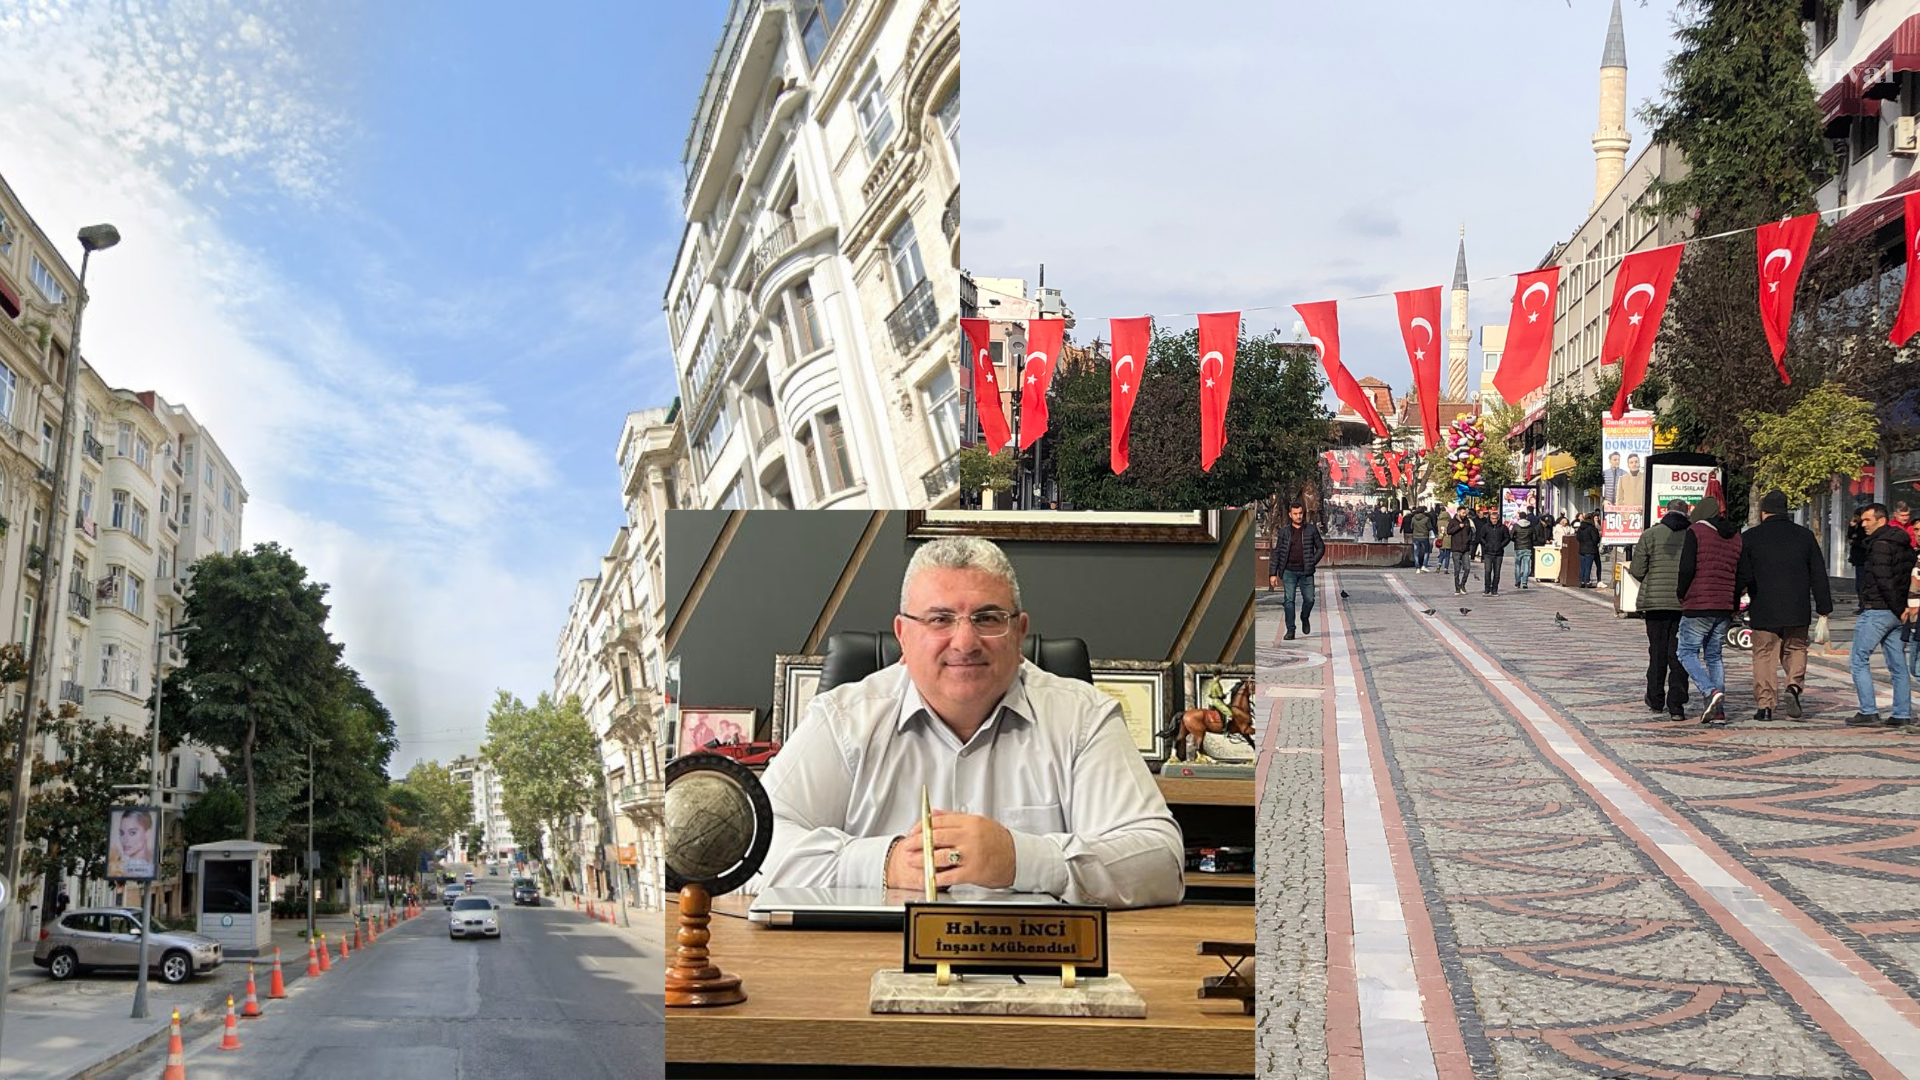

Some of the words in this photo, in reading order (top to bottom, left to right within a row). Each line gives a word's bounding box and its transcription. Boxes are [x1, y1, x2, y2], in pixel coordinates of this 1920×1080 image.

[1605, 440, 1651, 450] DONSUZ!
[946, 921, 1013, 934] Hakan
[1019, 920, 1066, 936] İNCİ
[936, 938, 985, 954] İnşaat
[991, 941, 1076, 954] Mühendisi
